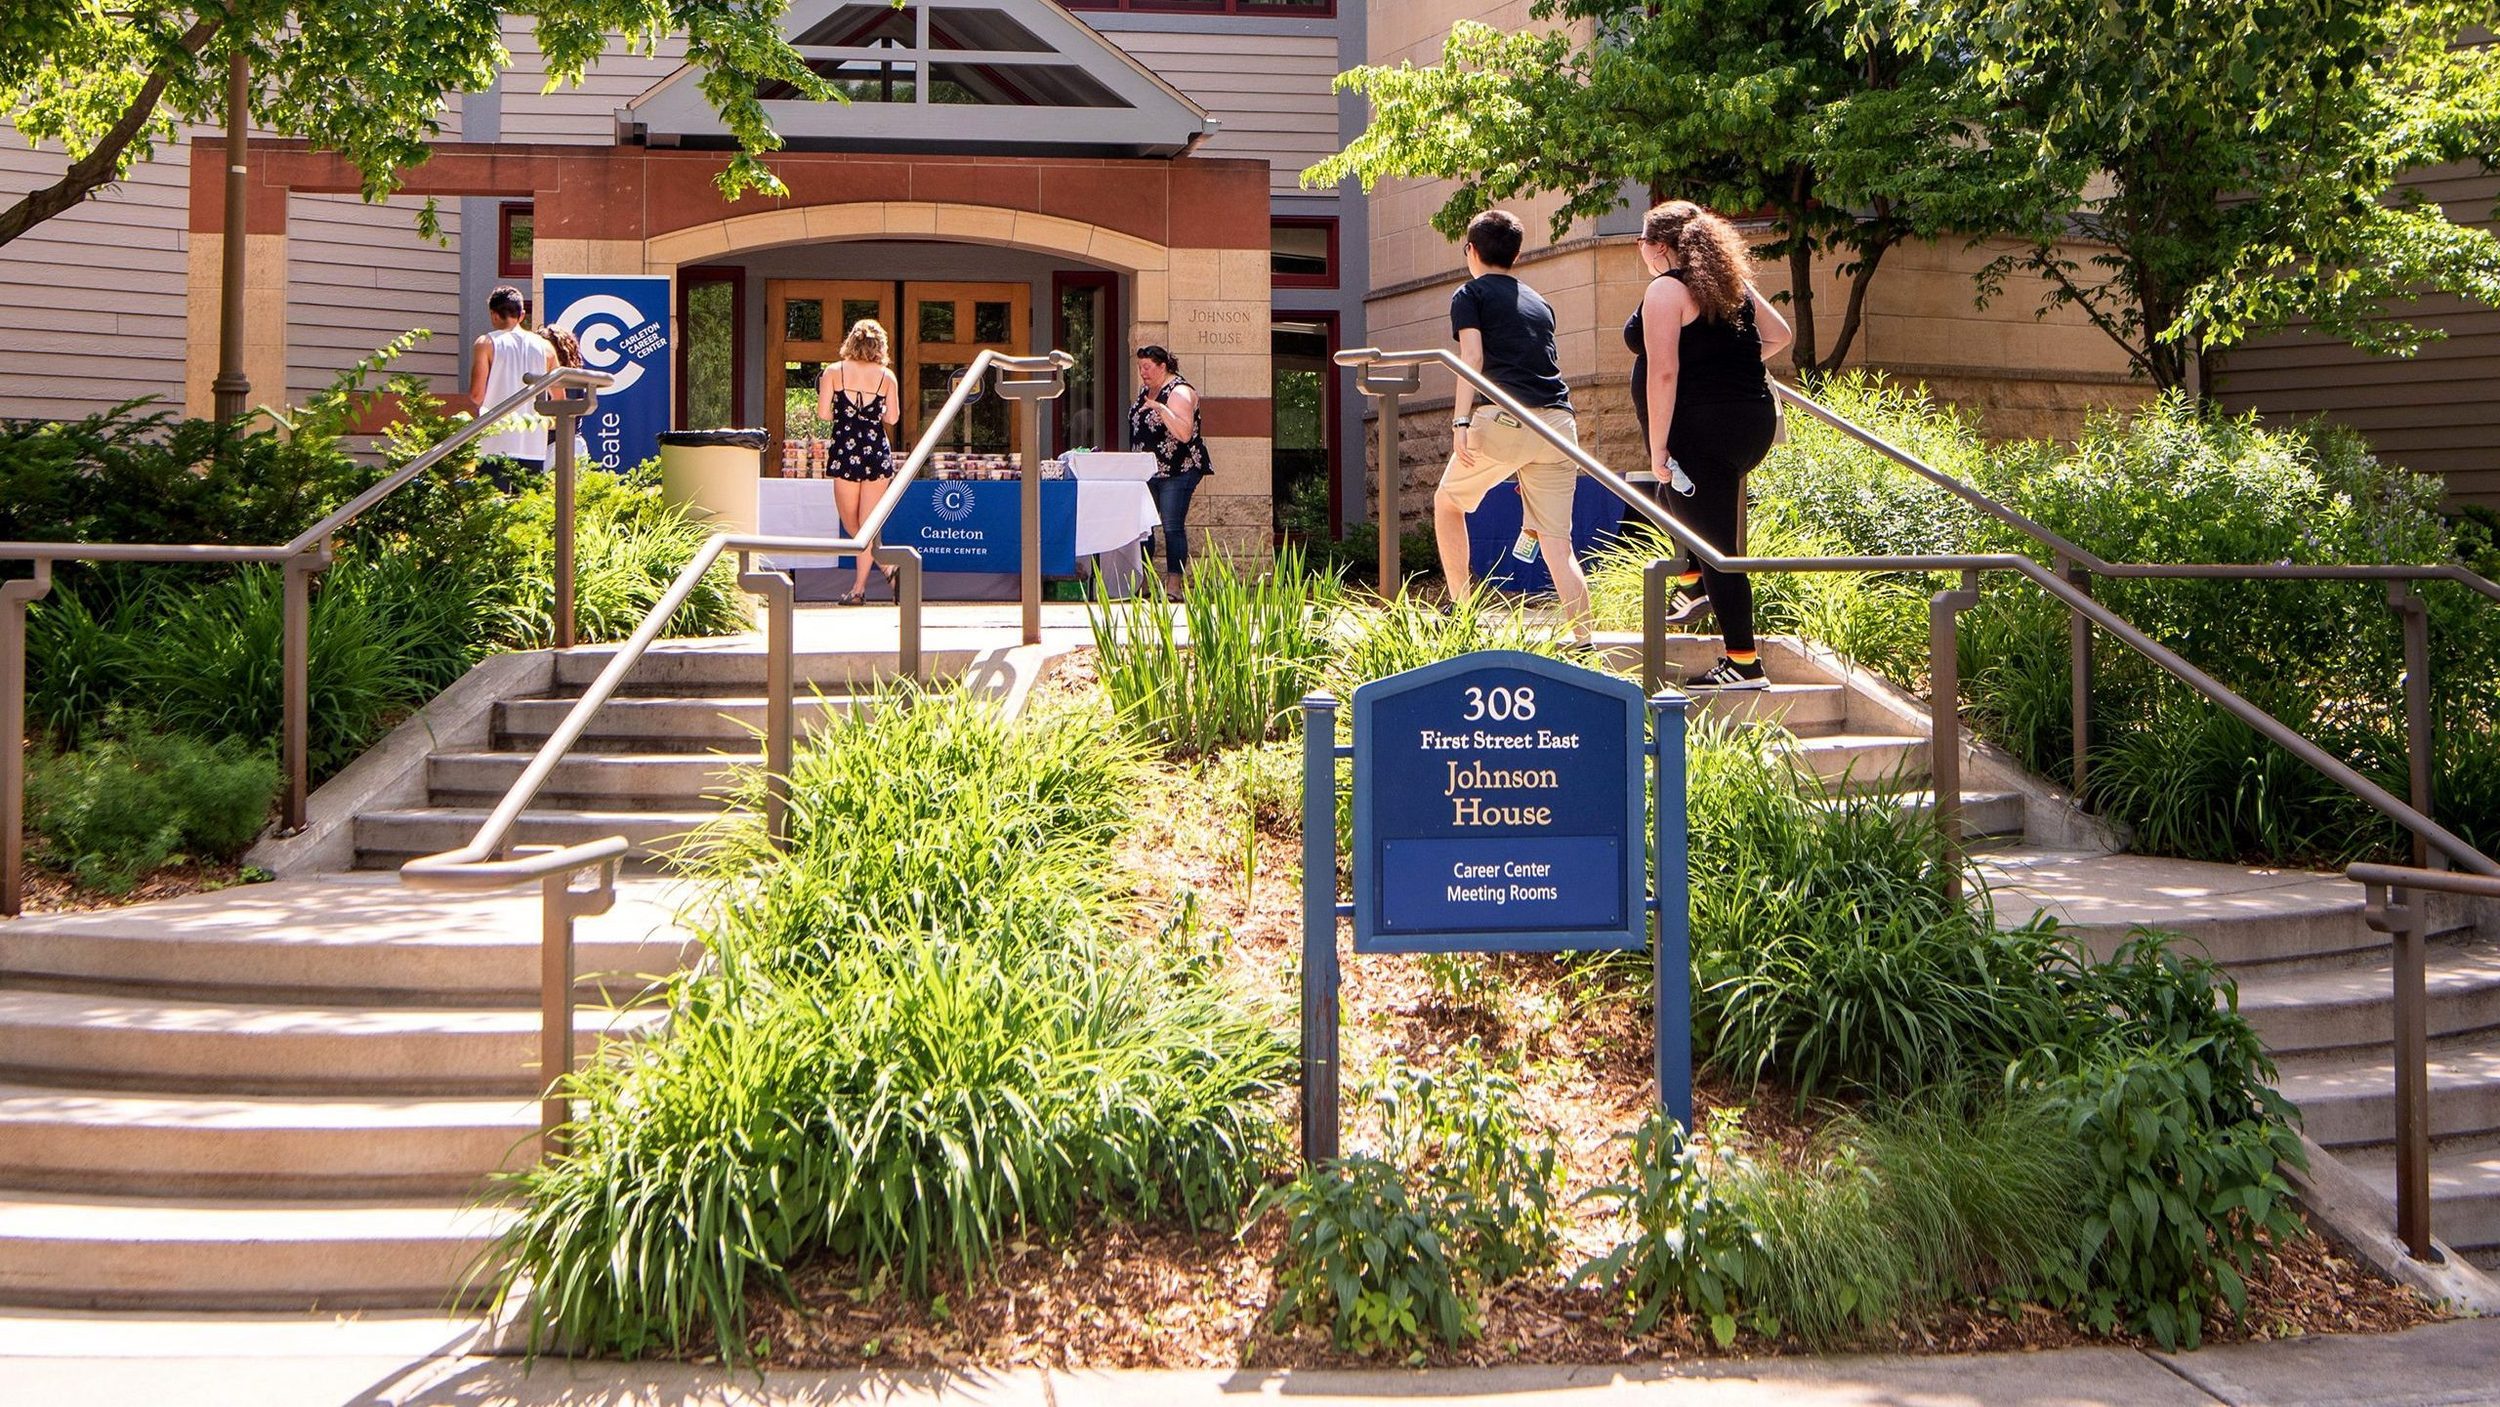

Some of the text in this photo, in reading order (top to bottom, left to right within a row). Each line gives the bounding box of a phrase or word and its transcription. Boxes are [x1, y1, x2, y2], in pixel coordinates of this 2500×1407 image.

[1188, 309, 1251, 323] JOHNSON
[619, 321, 661, 349] CARLETON
[628, 332, 659, 354] CAREER
[1198, 330, 1242, 344] HOUSE
[637, 338, 667, 358] CENTER
[598, 413, 620, 472] eate
[921, 525, 984, 540] Carleton
[917, 546, 988, 555] CAREER CENTER
[1463, 686, 1536, 721] 308
[1420, 730, 1580, 750] First Street East
[1444, 760, 1559, 796] Johnson
[1452, 798, 1552, 826] House
[1453, 861, 1551, 878] Career Center
[1447, 884, 1558, 905] Meeting Rooms
